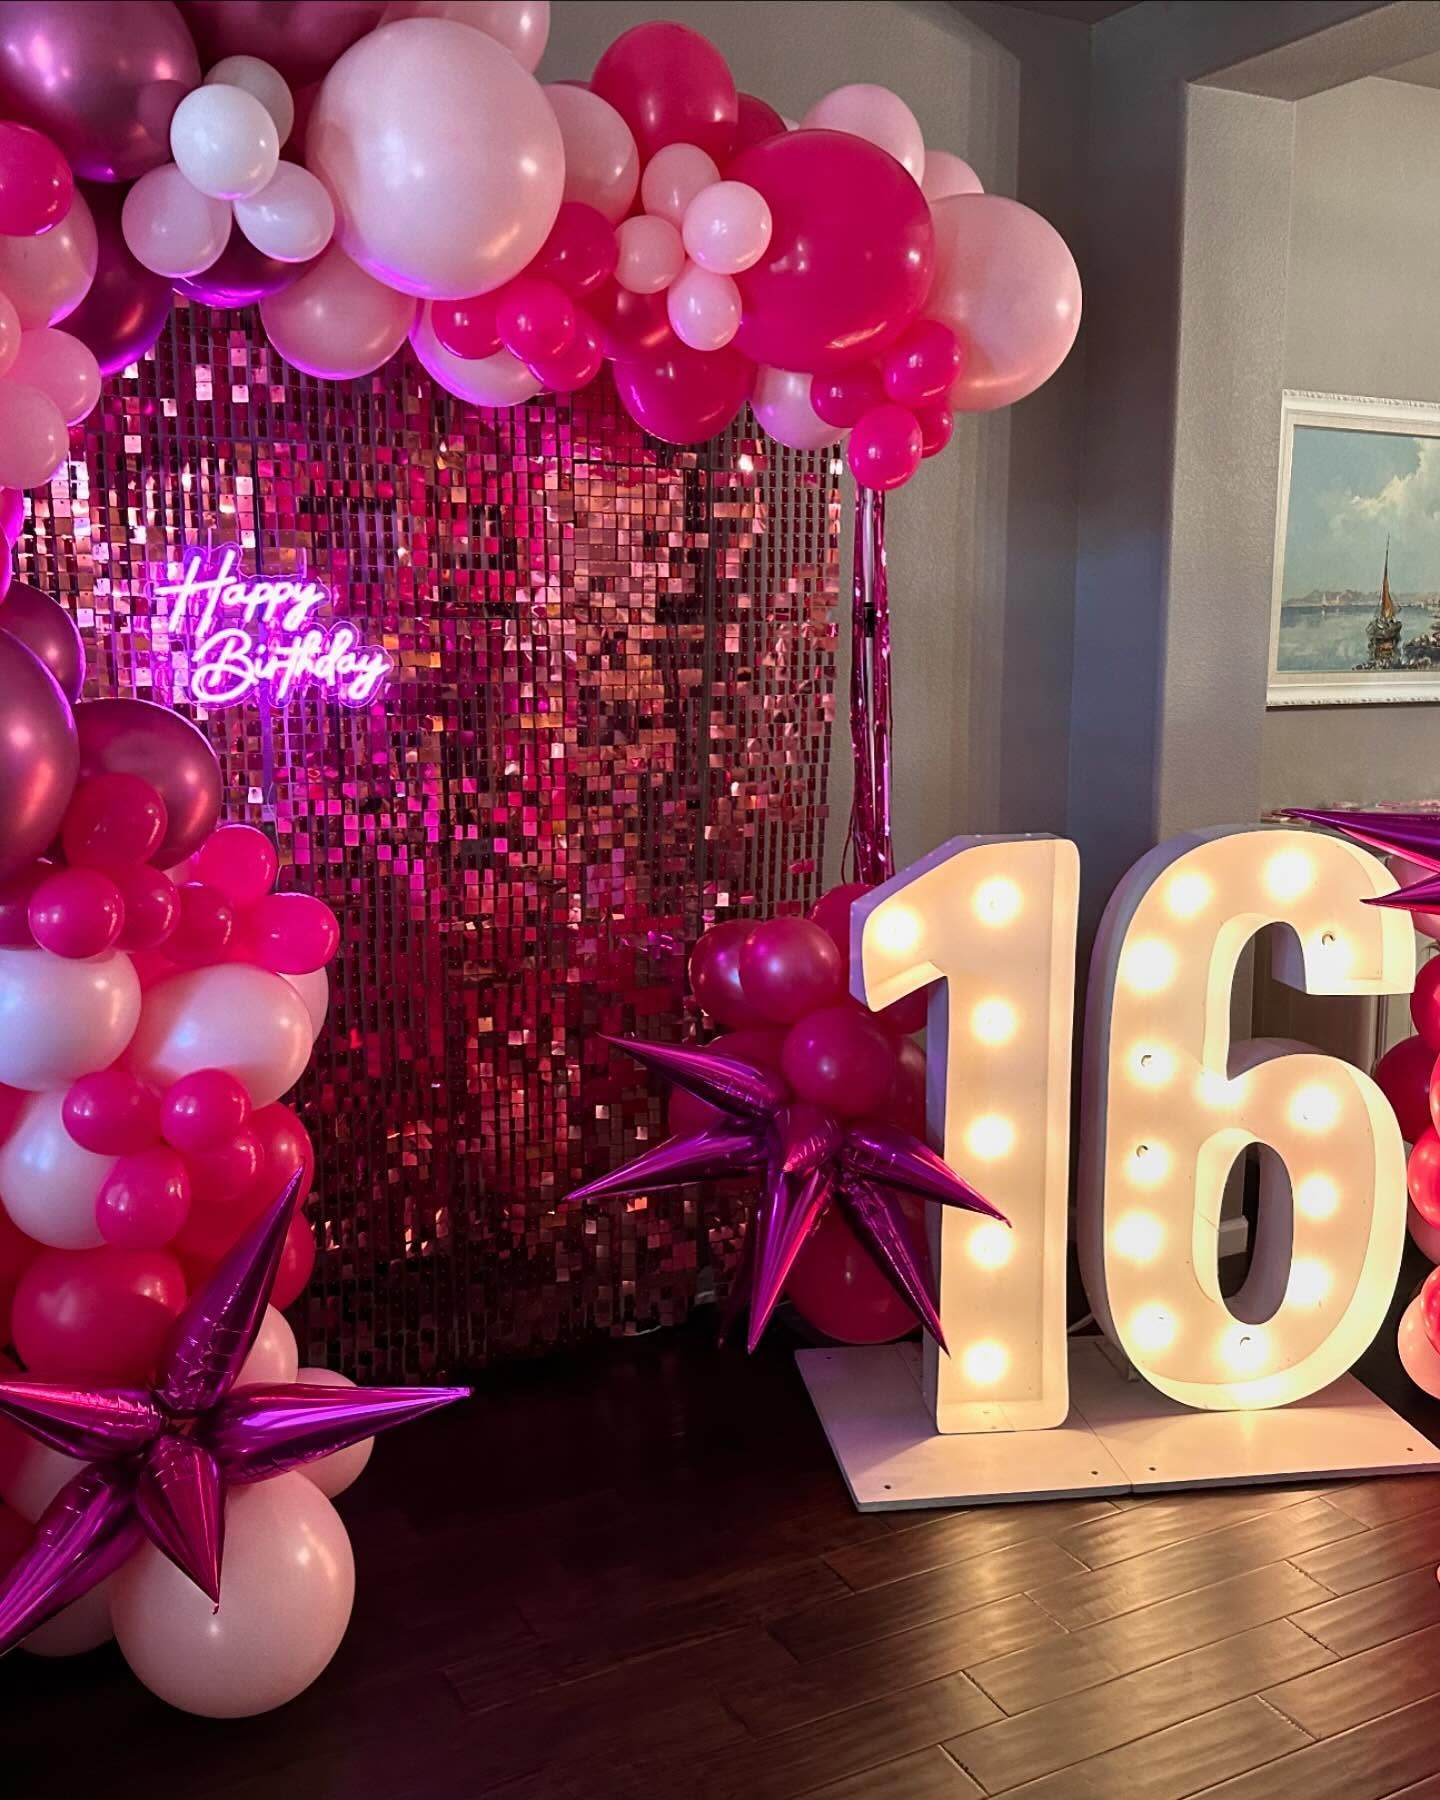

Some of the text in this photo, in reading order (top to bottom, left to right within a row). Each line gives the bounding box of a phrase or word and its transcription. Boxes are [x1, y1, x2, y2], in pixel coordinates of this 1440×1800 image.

[154, 549, 325, 636] Happy
[191, 628, 390, 702] Birthday
[850, 828, 1416, 1434] 16
